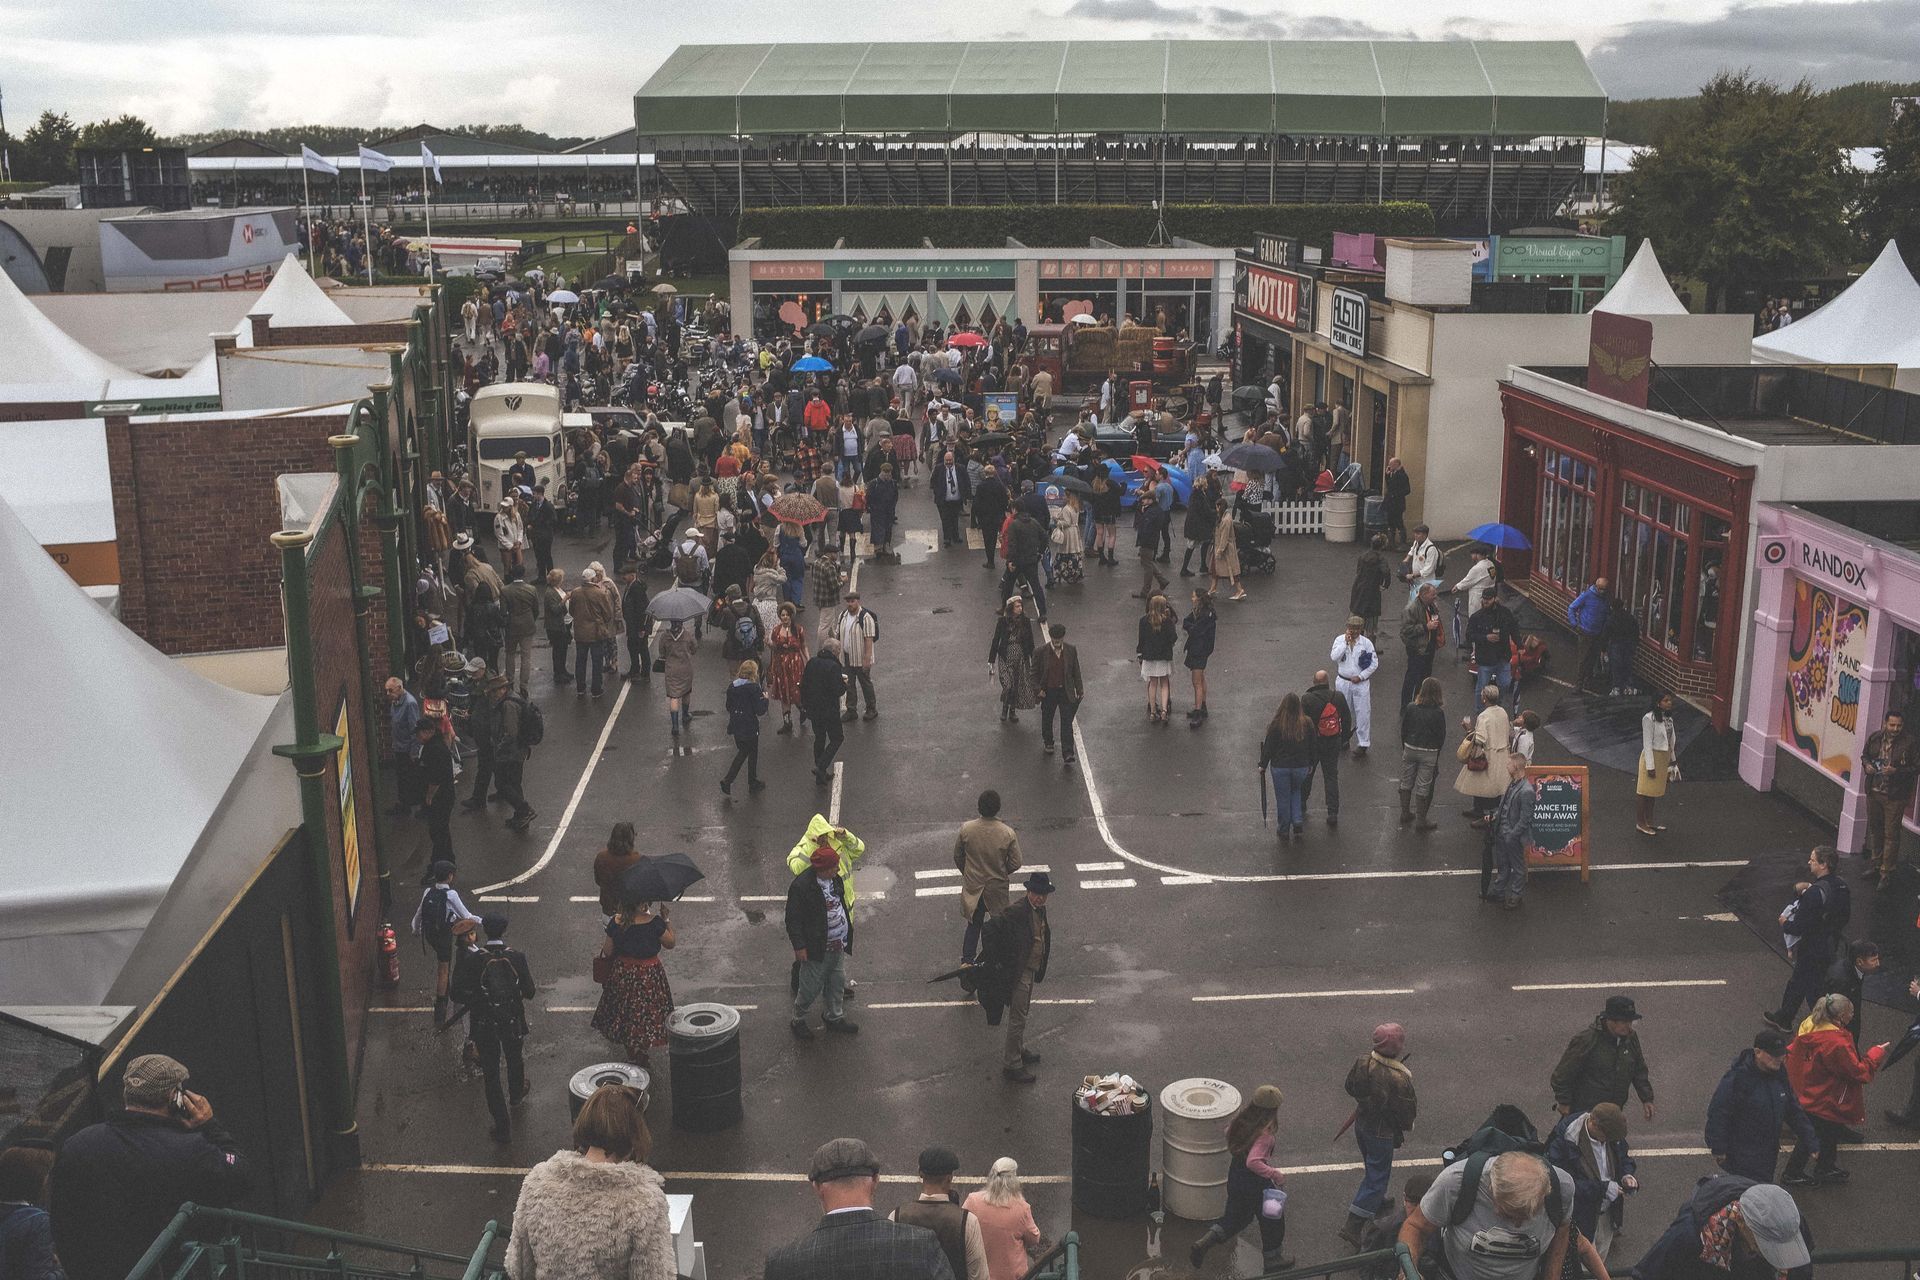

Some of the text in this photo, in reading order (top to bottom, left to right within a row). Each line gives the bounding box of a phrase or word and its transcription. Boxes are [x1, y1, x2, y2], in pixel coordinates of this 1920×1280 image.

[1260, 238, 1288, 266] GARAGE
[1526, 244, 1582, 258] Visual Eyes
[759, 266, 816, 274] BETTY'S
[1044, 263, 1159, 275] BETTY'S
[1248, 271, 1297, 324] MOTUL
[1333, 330, 1362, 351] PEDAL CARS
[1803, 542, 1867, 590] RANDOX
[1552, 812, 1577, 820] AWAY
